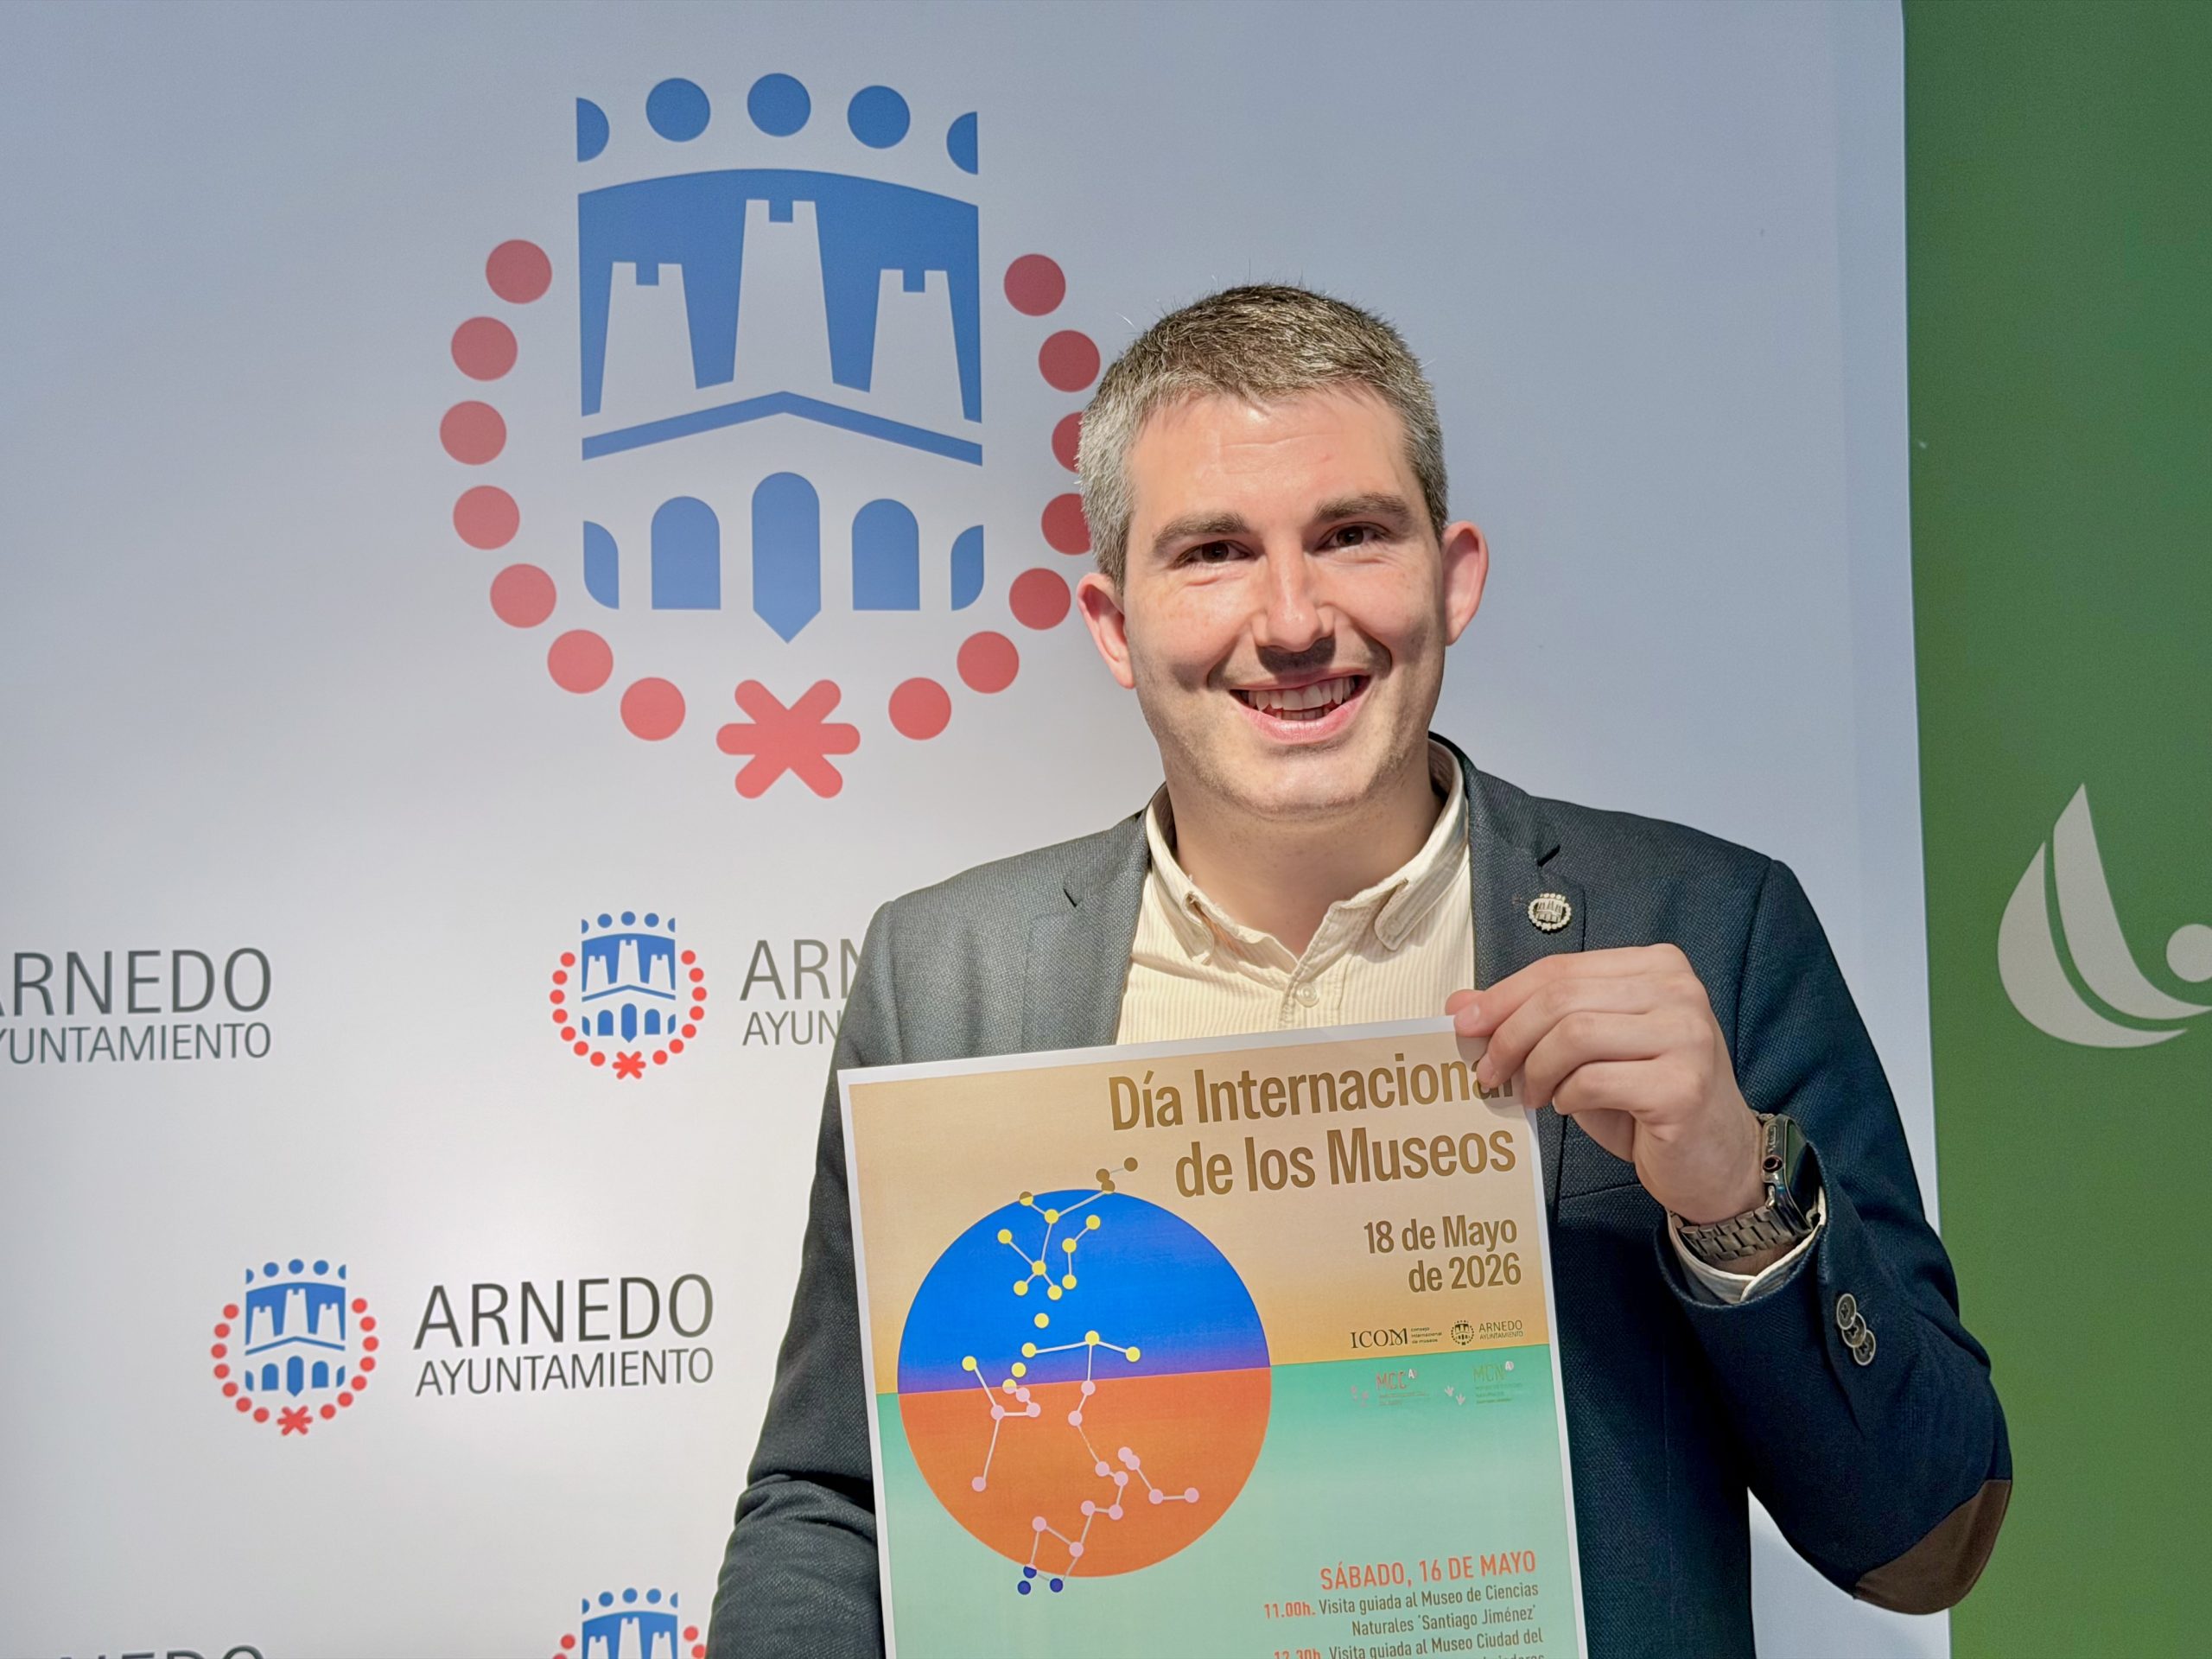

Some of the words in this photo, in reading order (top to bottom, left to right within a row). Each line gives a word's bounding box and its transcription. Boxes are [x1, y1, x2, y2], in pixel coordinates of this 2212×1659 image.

[0, 948, 272, 1016] RNEDO
[740, 938, 864, 1001] ARN
[0, 1022, 271, 1065] UNTAMIENTO
[1109, 1070, 1183, 1131] Día
[1175, 1141, 1233, 1198] de
[1244, 1136, 1315, 1192] los
[1326, 1127, 1516, 1186] Museos
[1363, 1221, 1395, 1254] 18
[1402, 1218, 1435, 1251] de
[1442, 1214, 1517, 1255] Mayo
[1408, 1260, 1443, 1293] de
[1449, 1252, 1522, 1290] 2026
[413, 1273, 715, 1350] ARNEDO
[1479, 1319, 1522, 1332] ARNEDO
[1351, 1328, 1408, 1349] ICOM
[1479, 1331, 1523, 1340] AYUNTAMIENTO
[415, 1347, 714, 1397] AYUNTAMIENTO
[1319, 1561, 1413, 1590] SÁBADO,
[1419, 1560, 1441, 1582] 16
[1448, 1556, 1474, 1580] DE
[1480, 1550, 1536, 1576] MAYO
[1264, 1601, 1316, 1618] 11.00h.
[1319, 1599, 1355, 1614] Visita
[1359, 1594, 1402, 1615] guiada
[1405, 1592, 1417, 1608] al
[1421, 1590, 1463, 1606] Museo
[1466, 1586, 1481, 1602] de
[1485, 1582, 1539, 1600] Ciencias
[1329, 1645, 1365, 1659] Visita
[1370, 1641, 1412, 1659] guiada
[1415, 1638, 1427, 1655] al
[1431, 1637, 1472, 1654] Museo
[1477, 1630, 1520, 1649] Ciudad
[1523, 1628, 1543, 1643] del
[1351, 1618, 1414, 1637] Naturales
